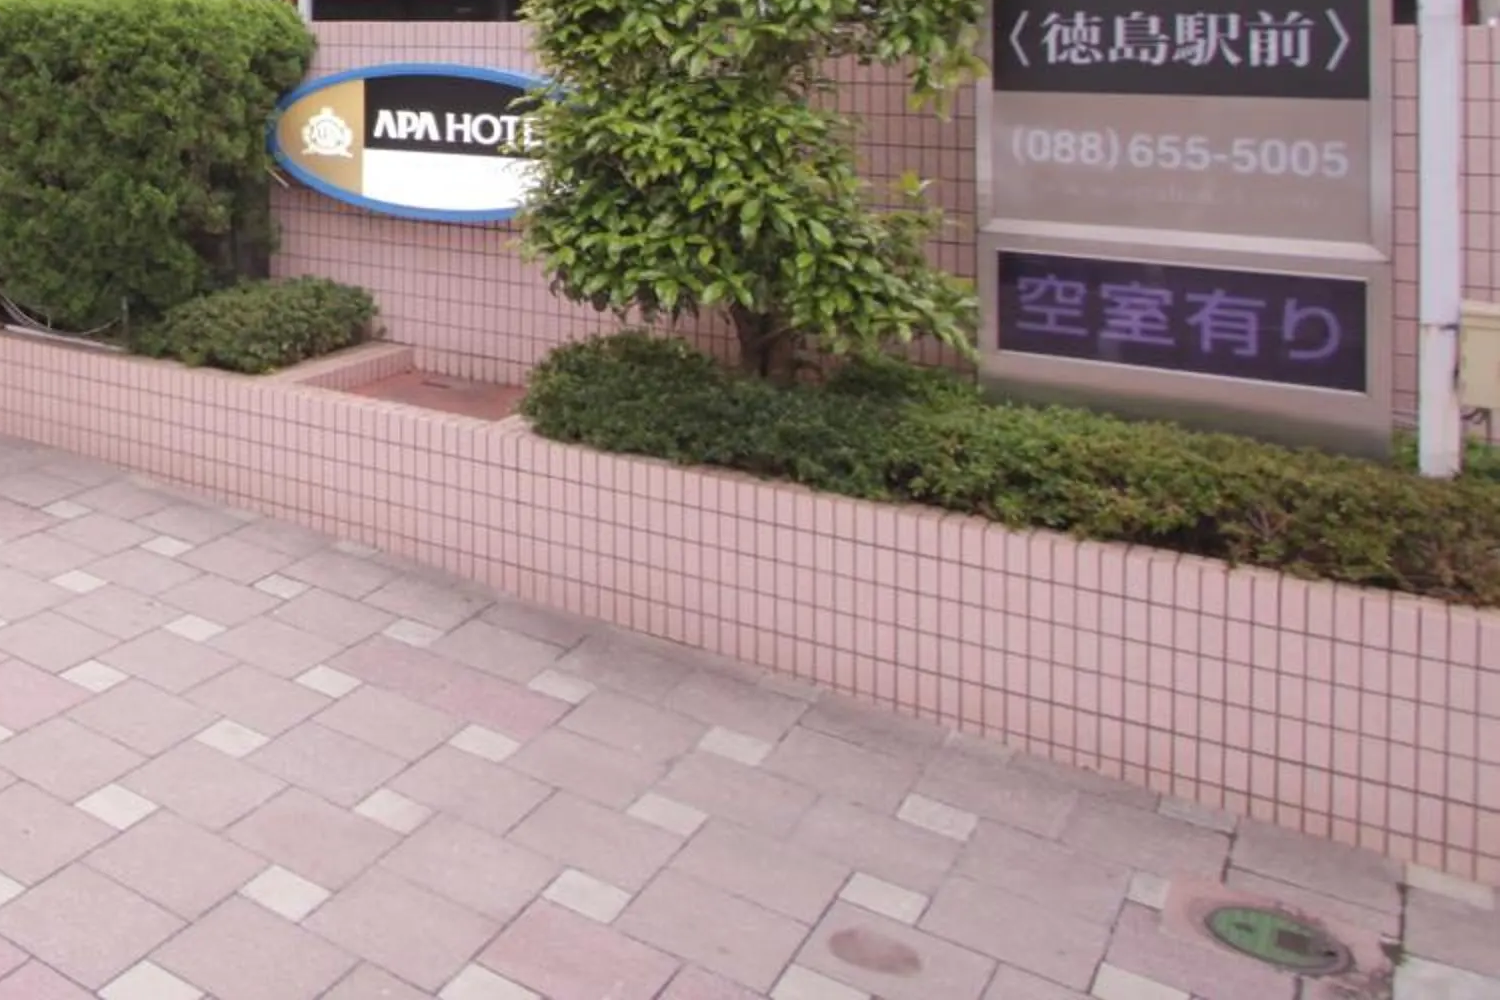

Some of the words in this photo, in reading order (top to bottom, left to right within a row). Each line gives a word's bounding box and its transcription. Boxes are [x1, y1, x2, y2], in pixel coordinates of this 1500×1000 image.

[373, 109, 441, 141] APA
[445, 112, 544, 147] HOTE
[1015, 273, 1342, 361] 空室有り
